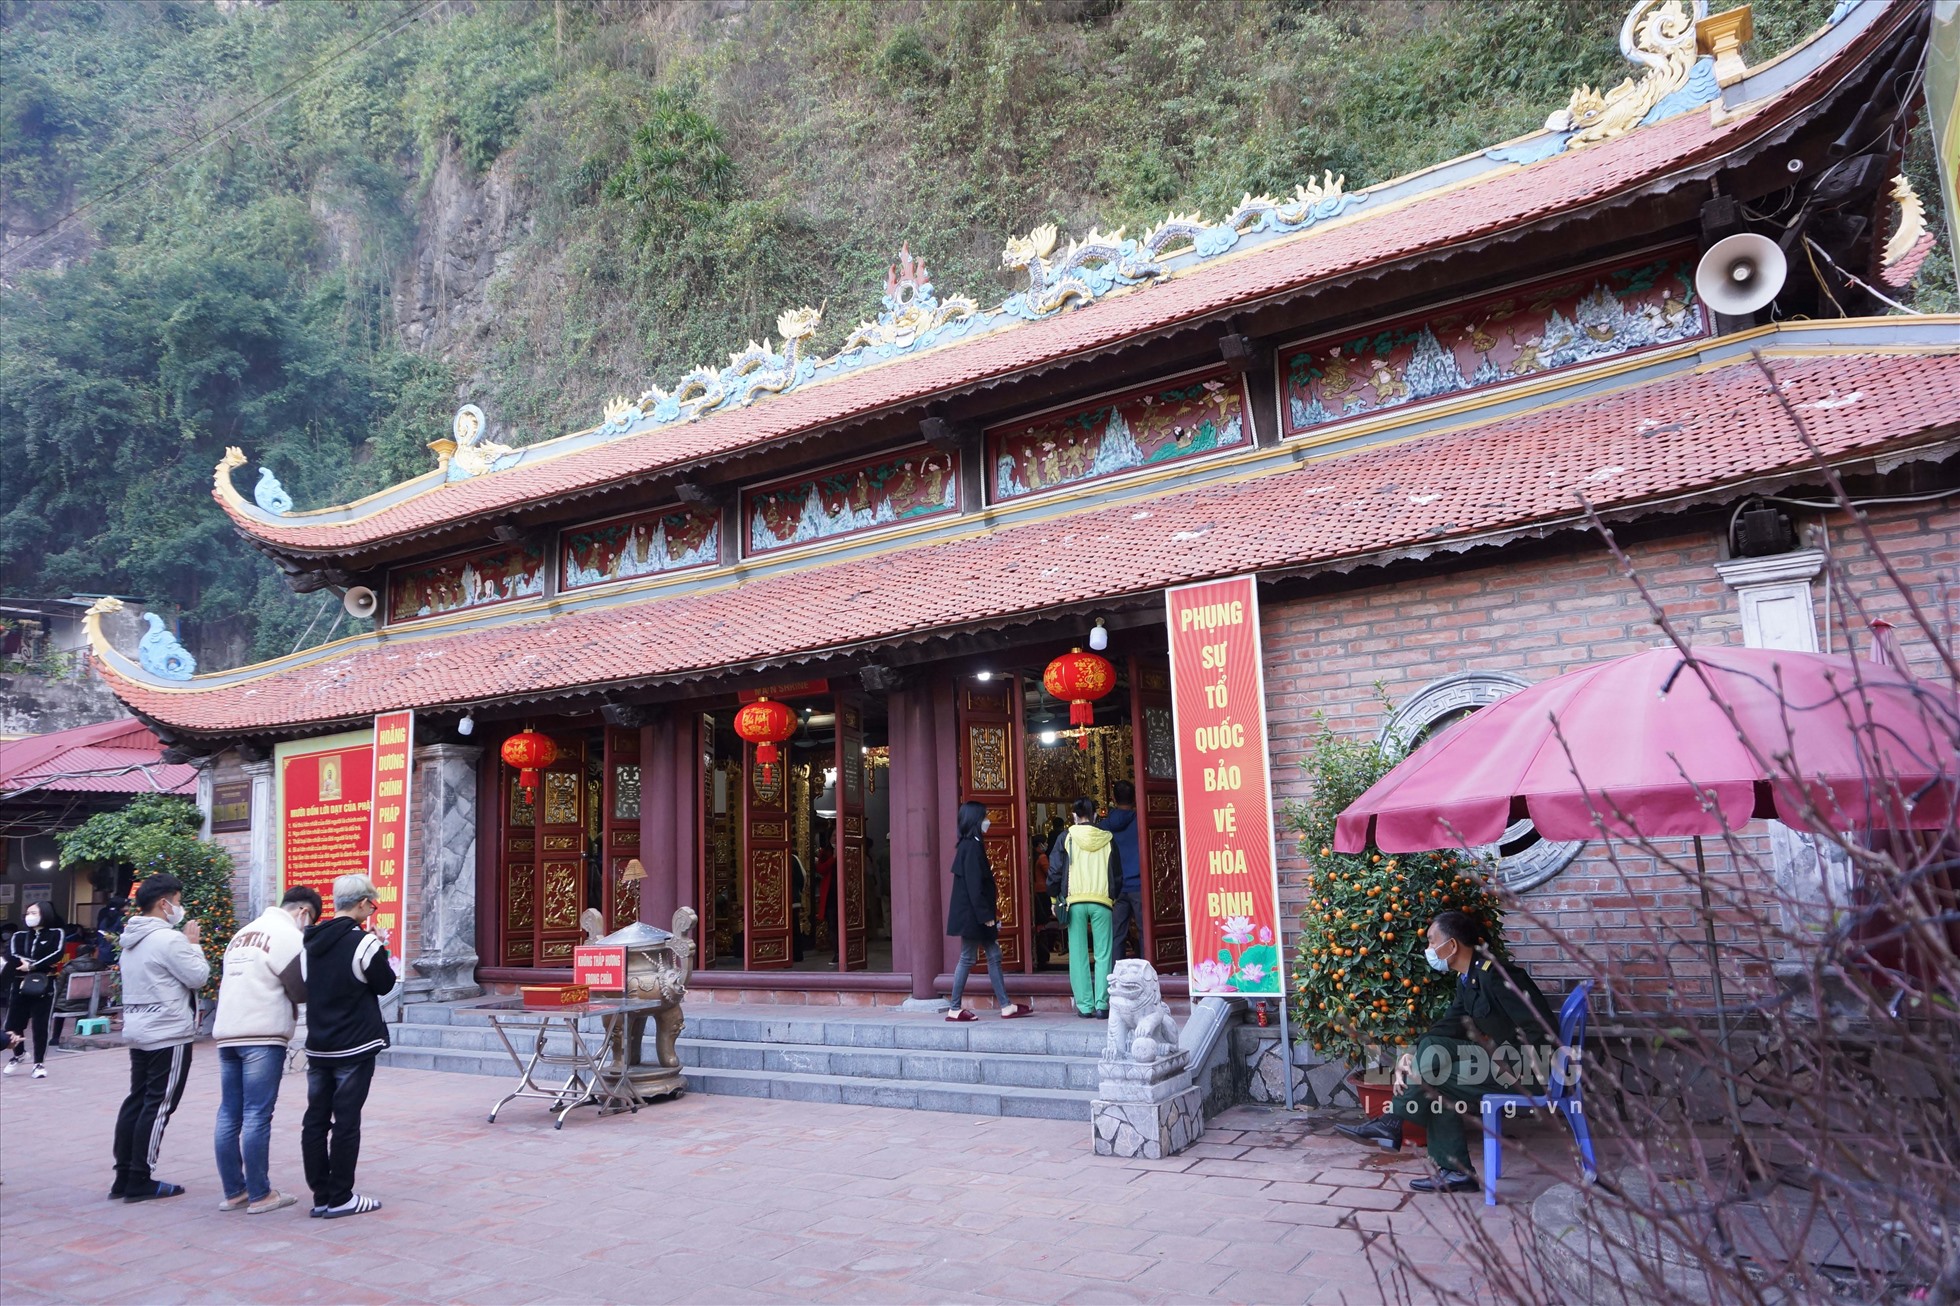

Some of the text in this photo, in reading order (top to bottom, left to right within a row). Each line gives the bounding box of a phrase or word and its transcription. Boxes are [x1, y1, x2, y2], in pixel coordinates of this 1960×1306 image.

[1180, 599, 1243, 634] PHỤNG
[1201, 640, 1228, 673] SỰ
[1204, 674, 1229, 709] TỔ
[1195, 714, 1245, 755] QUỐC
[378, 753, 405, 772] DƯƠNG
[1203, 759, 1242, 792] BẢO
[378, 776, 403, 797] CHÍNH
[343, 799, 357, 813] CỦA
[357, 799, 371, 812] PHẬ
[378, 804, 401, 823] PHÁP
[1213, 803, 1237, 837] VỆ
[381, 831, 395, 853] LỢI
[379, 859, 395, 881] LẠC
[1208, 843, 1248, 875] HÒA
[1207, 886, 1254, 917] BÌNH
[376, 912, 396, 929] SINH
[600, 971, 613, 985] CHÙA
